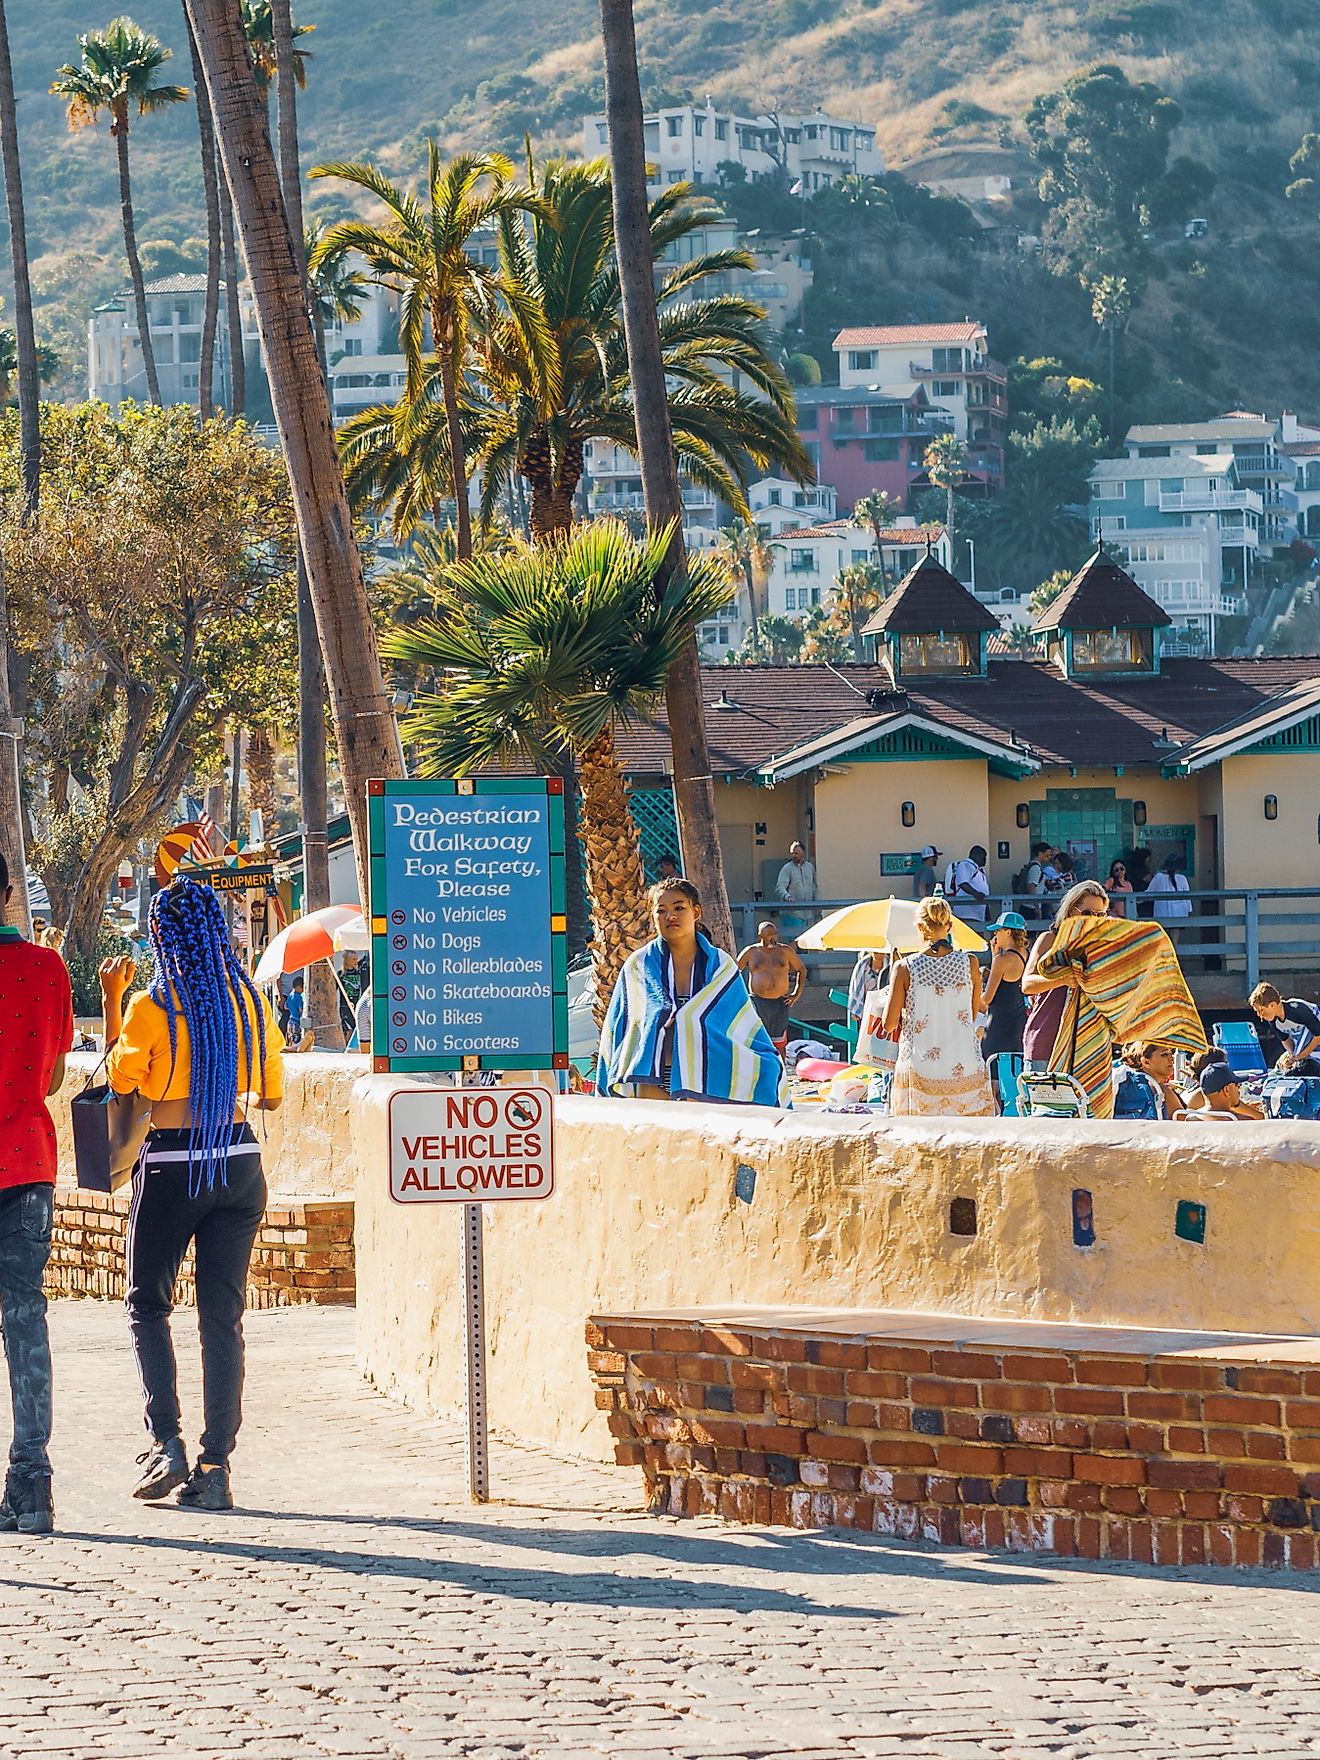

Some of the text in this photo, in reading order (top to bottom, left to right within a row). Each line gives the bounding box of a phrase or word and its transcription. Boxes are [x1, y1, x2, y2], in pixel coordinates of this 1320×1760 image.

[392, 803, 541, 827] Pedestrian
[409, 828, 532, 854] Walkway
[404, 857, 542, 879] For Safety,
[210, 873, 273, 889] EQUIPMENT
[437, 879, 511, 898] Please
[413, 905, 507, 923] No Vehicles
[413, 932, 481, 952] No Dogs
[413, 957, 543, 975] No Rollerblades
[414, 982, 551, 1000] No Skateboards
[414, 1008, 483, 1025] No Bikes
[414, 1034, 520, 1051] No Scooters
[446, 1095, 499, 1129] NO
[401, 1133, 542, 1160] VEHICLES
[400, 1163, 544, 1191] ALLOWED
